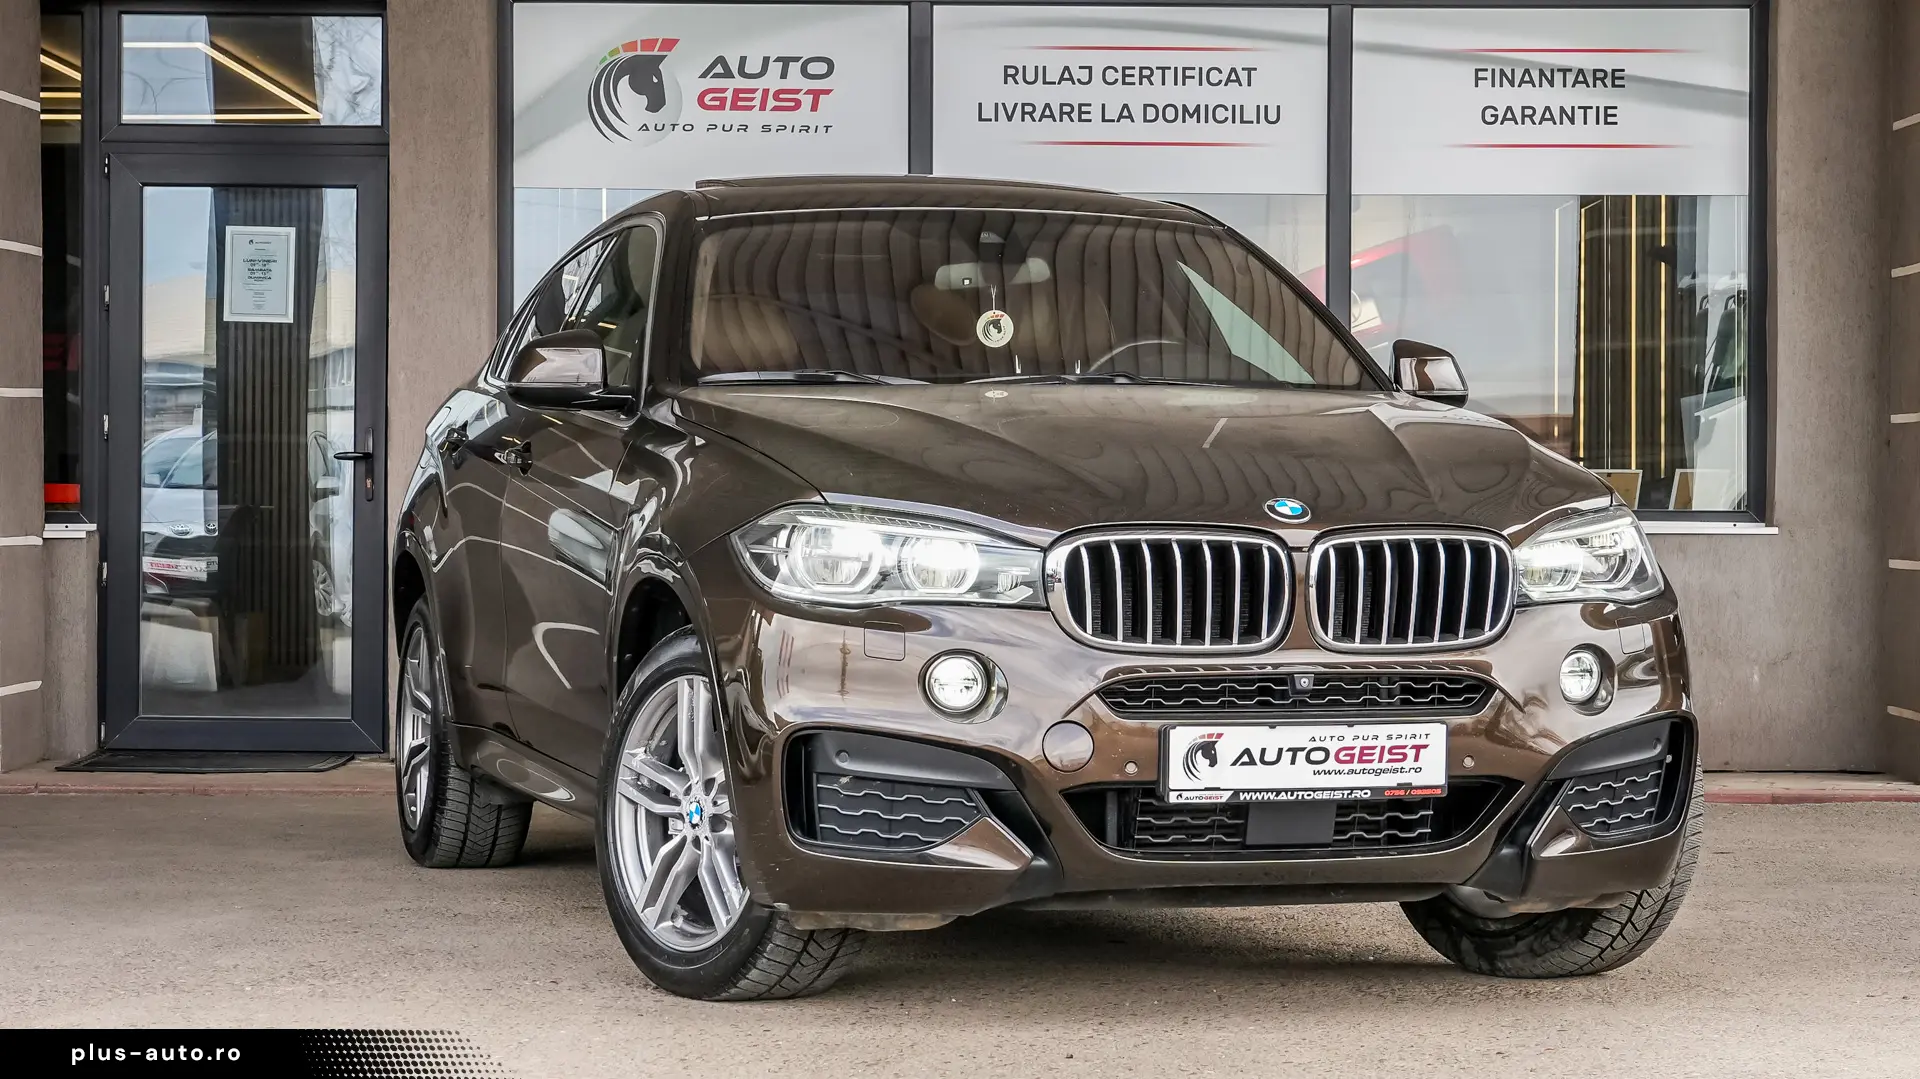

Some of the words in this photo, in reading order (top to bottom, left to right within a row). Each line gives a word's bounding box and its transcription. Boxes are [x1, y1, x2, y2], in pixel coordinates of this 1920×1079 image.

[697, 55, 835, 80] AUTO
[1003, 65, 1093, 87] RULAJ
[1101, 66, 1258, 87] CERTIFICAT
[1474, 68, 1626, 89] FINANTARE
[696, 88, 834, 112] GEIST
[977, 102, 1093, 124] LIVRARE
[1101, 103, 1134, 124] LA
[1142, 103, 1281, 125] DOMICILIU
[1481, 105, 1619, 126] GARANTIE
[637, 123, 695, 133] AUTO
[706, 123, 749, 133] PUR
[760, 124, 833, 134] SPIRIT
[1386, 733, 1431, 741] SPIRIT
[1312, 765, 1422, 777] www.autogeist.ro
[1239, 789, 1372, 801] WWW.AUTOGEIST.RO
